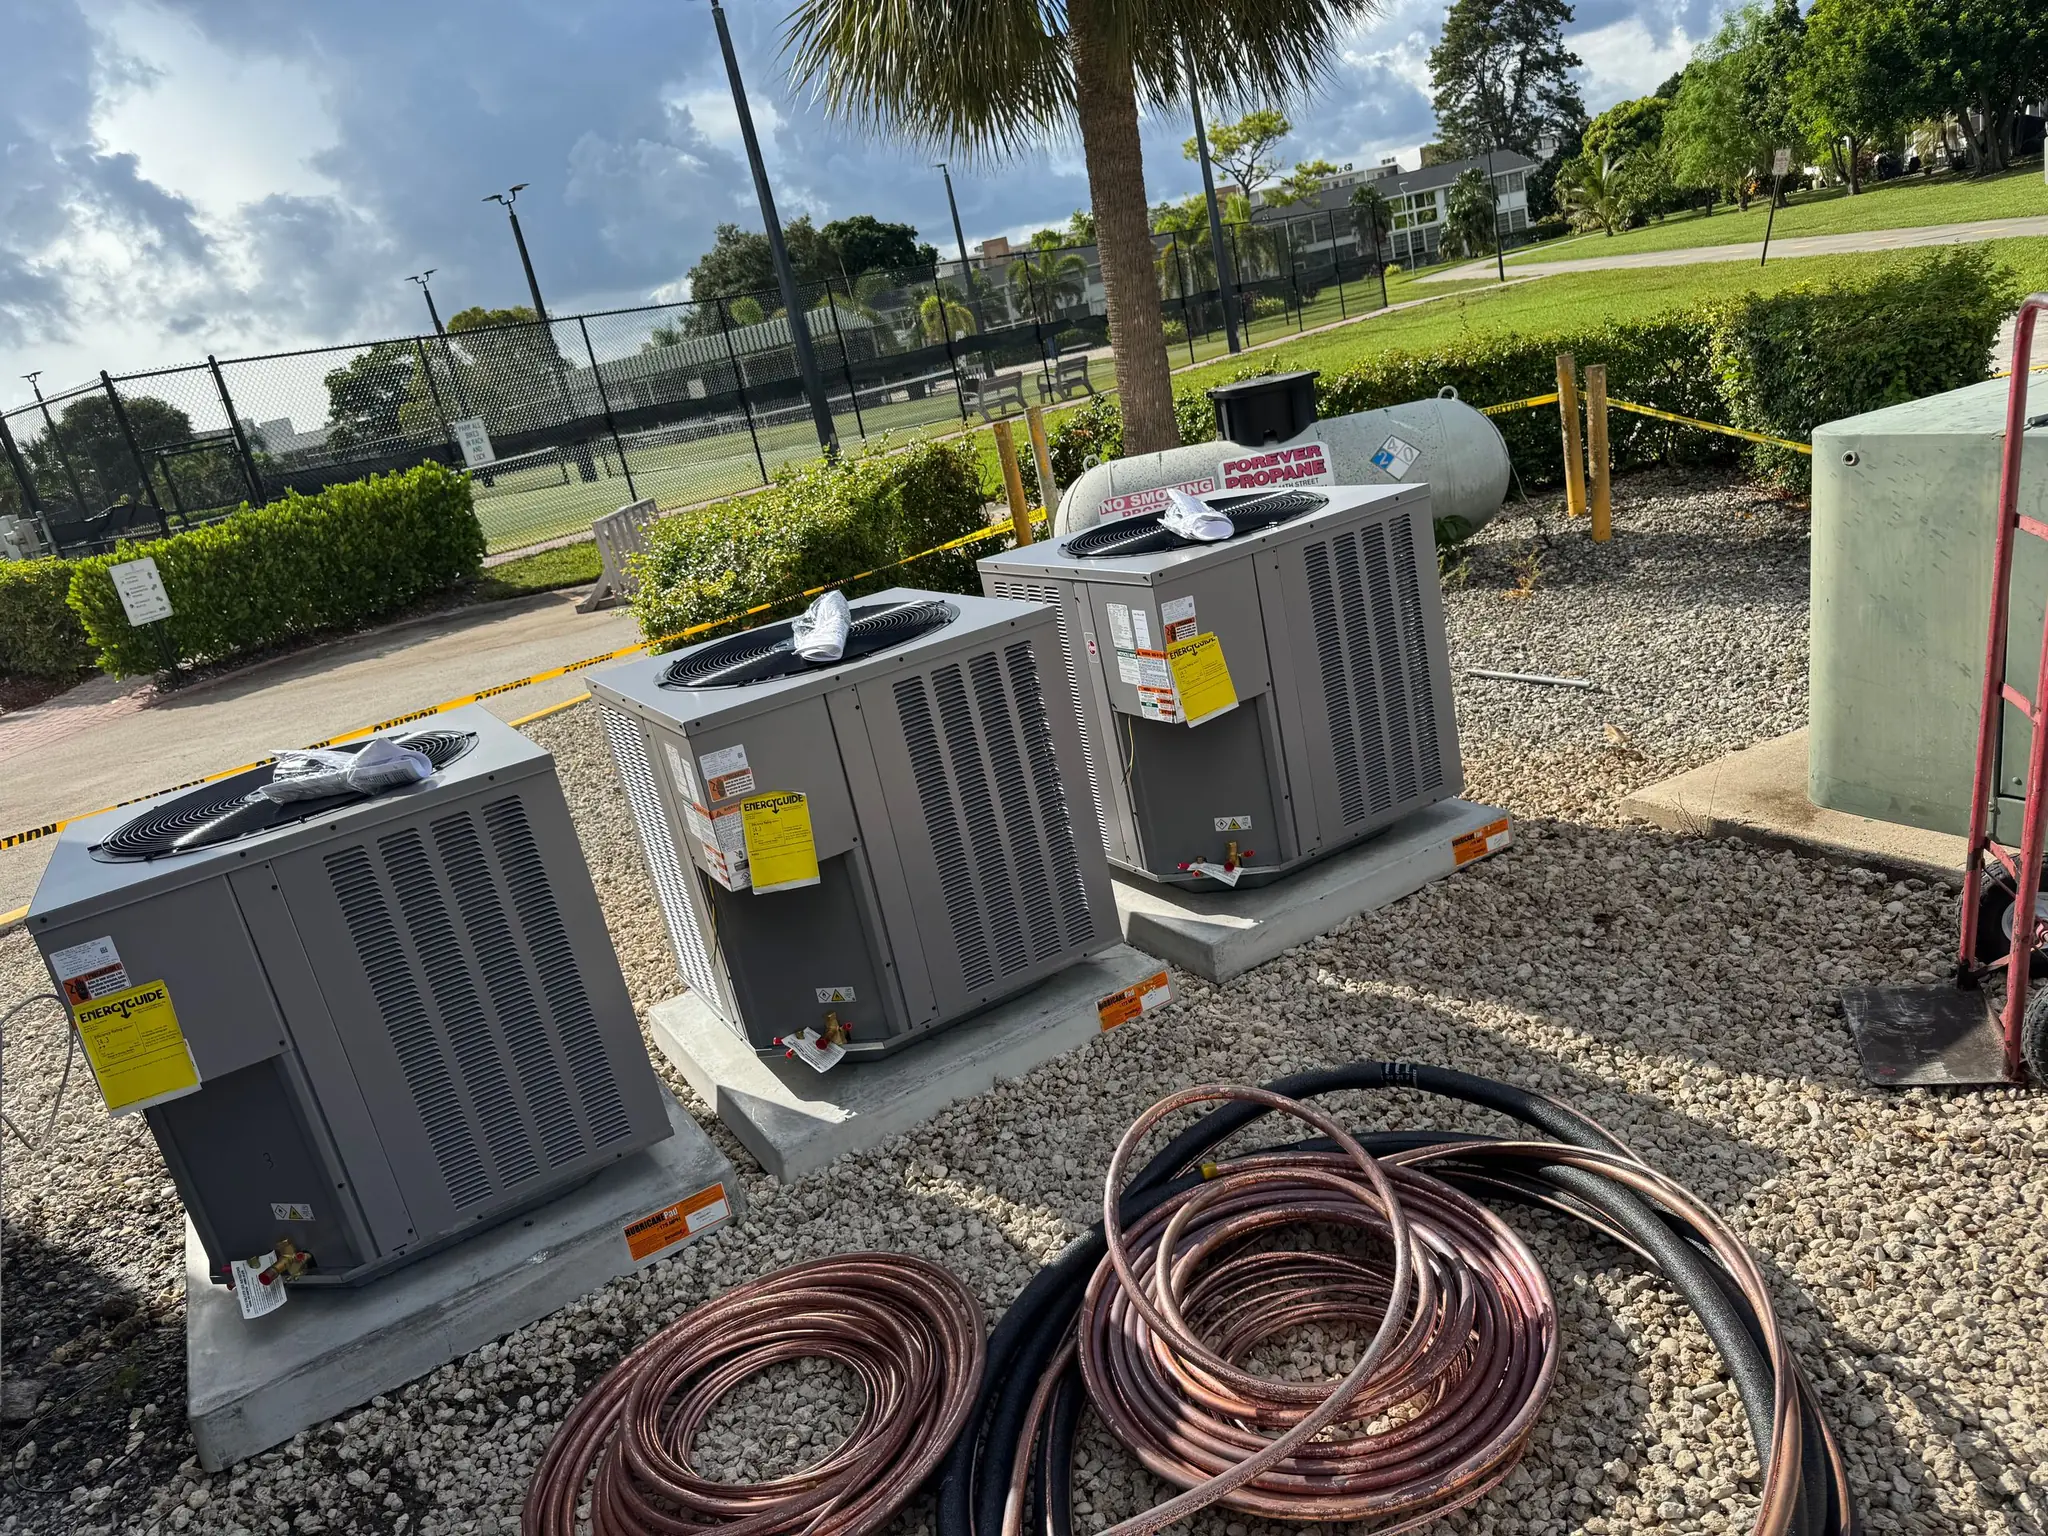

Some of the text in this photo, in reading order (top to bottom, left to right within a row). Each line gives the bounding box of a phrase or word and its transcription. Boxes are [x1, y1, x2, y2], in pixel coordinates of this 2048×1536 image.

[1224, 445, 1322, 475] FOREVER
[1378, 452, 1389, 468] 2
[1387, 439, 1414, 463] 4 0
[1225, 459, 1327, 488] PROPANE
[1294, 477, 1319, 487] STREET
[1101, 479, 1212, 515] NO SMOING
[744, 794, 804, 813] ENERGYGUIDE
[0, 823, 57, 847] TION
[79, 989, 165, 1024] ENERGYGUIDE
